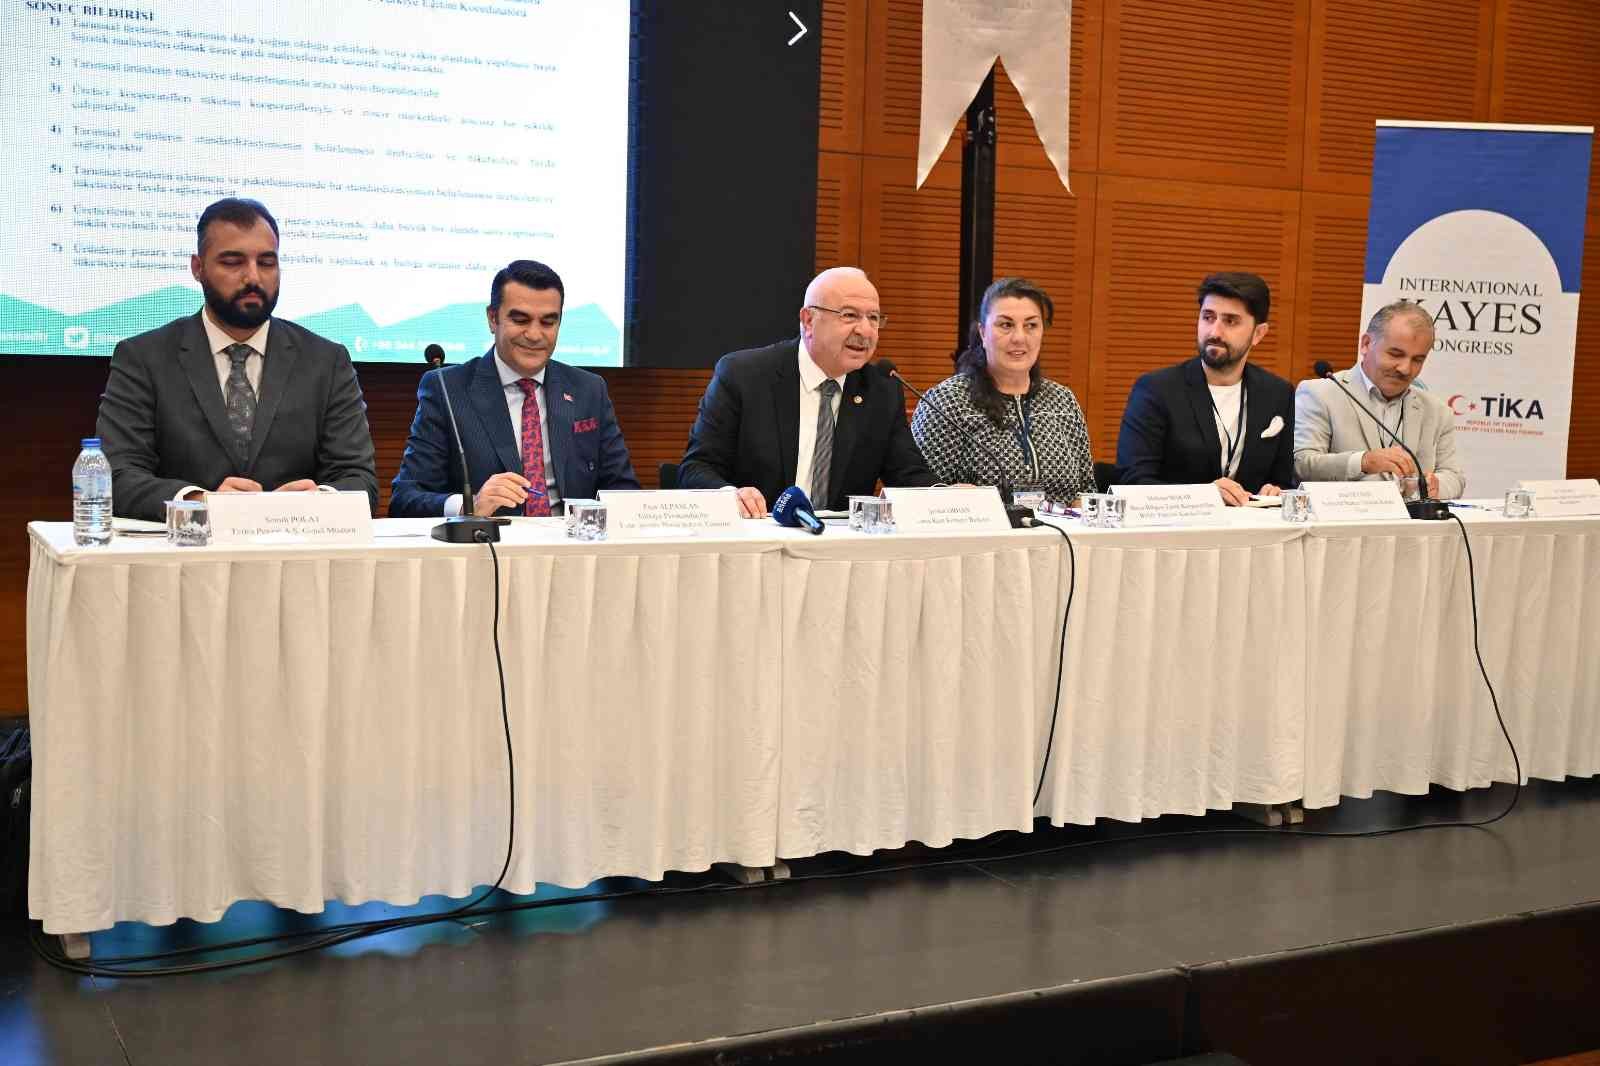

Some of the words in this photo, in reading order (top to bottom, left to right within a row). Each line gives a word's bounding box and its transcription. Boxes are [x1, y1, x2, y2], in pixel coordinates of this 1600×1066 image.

[83, 5, 154, 21] BİLDİRİSİ
[1399, 277, 1543, 297] INTERNATIONAL
[1432, 339, 1513, 355] ONGRESS
[1480, 393, 1544, 420] TİKA
